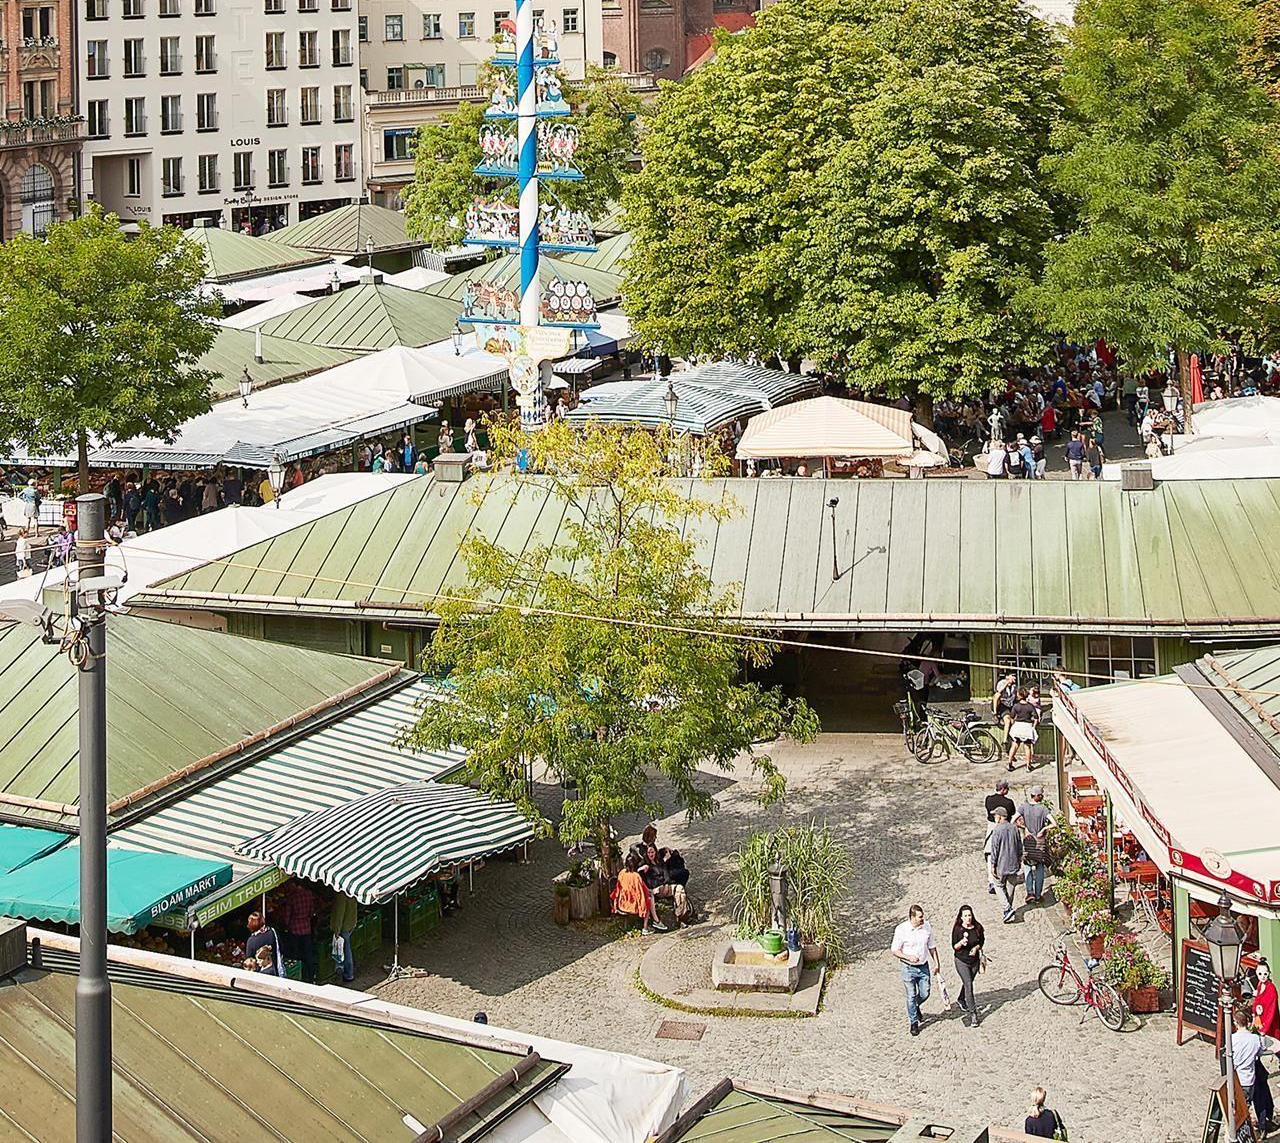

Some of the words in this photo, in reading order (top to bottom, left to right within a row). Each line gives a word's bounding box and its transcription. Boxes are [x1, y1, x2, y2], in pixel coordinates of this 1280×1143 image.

[230, 137, 261, 147] LOUIS
[151, 899, 169, 918] BIO
[169, 892, 184, 906] AM
[185, 874, 217, 899] MARKT
[199, 898, 233, 924] BEIM
